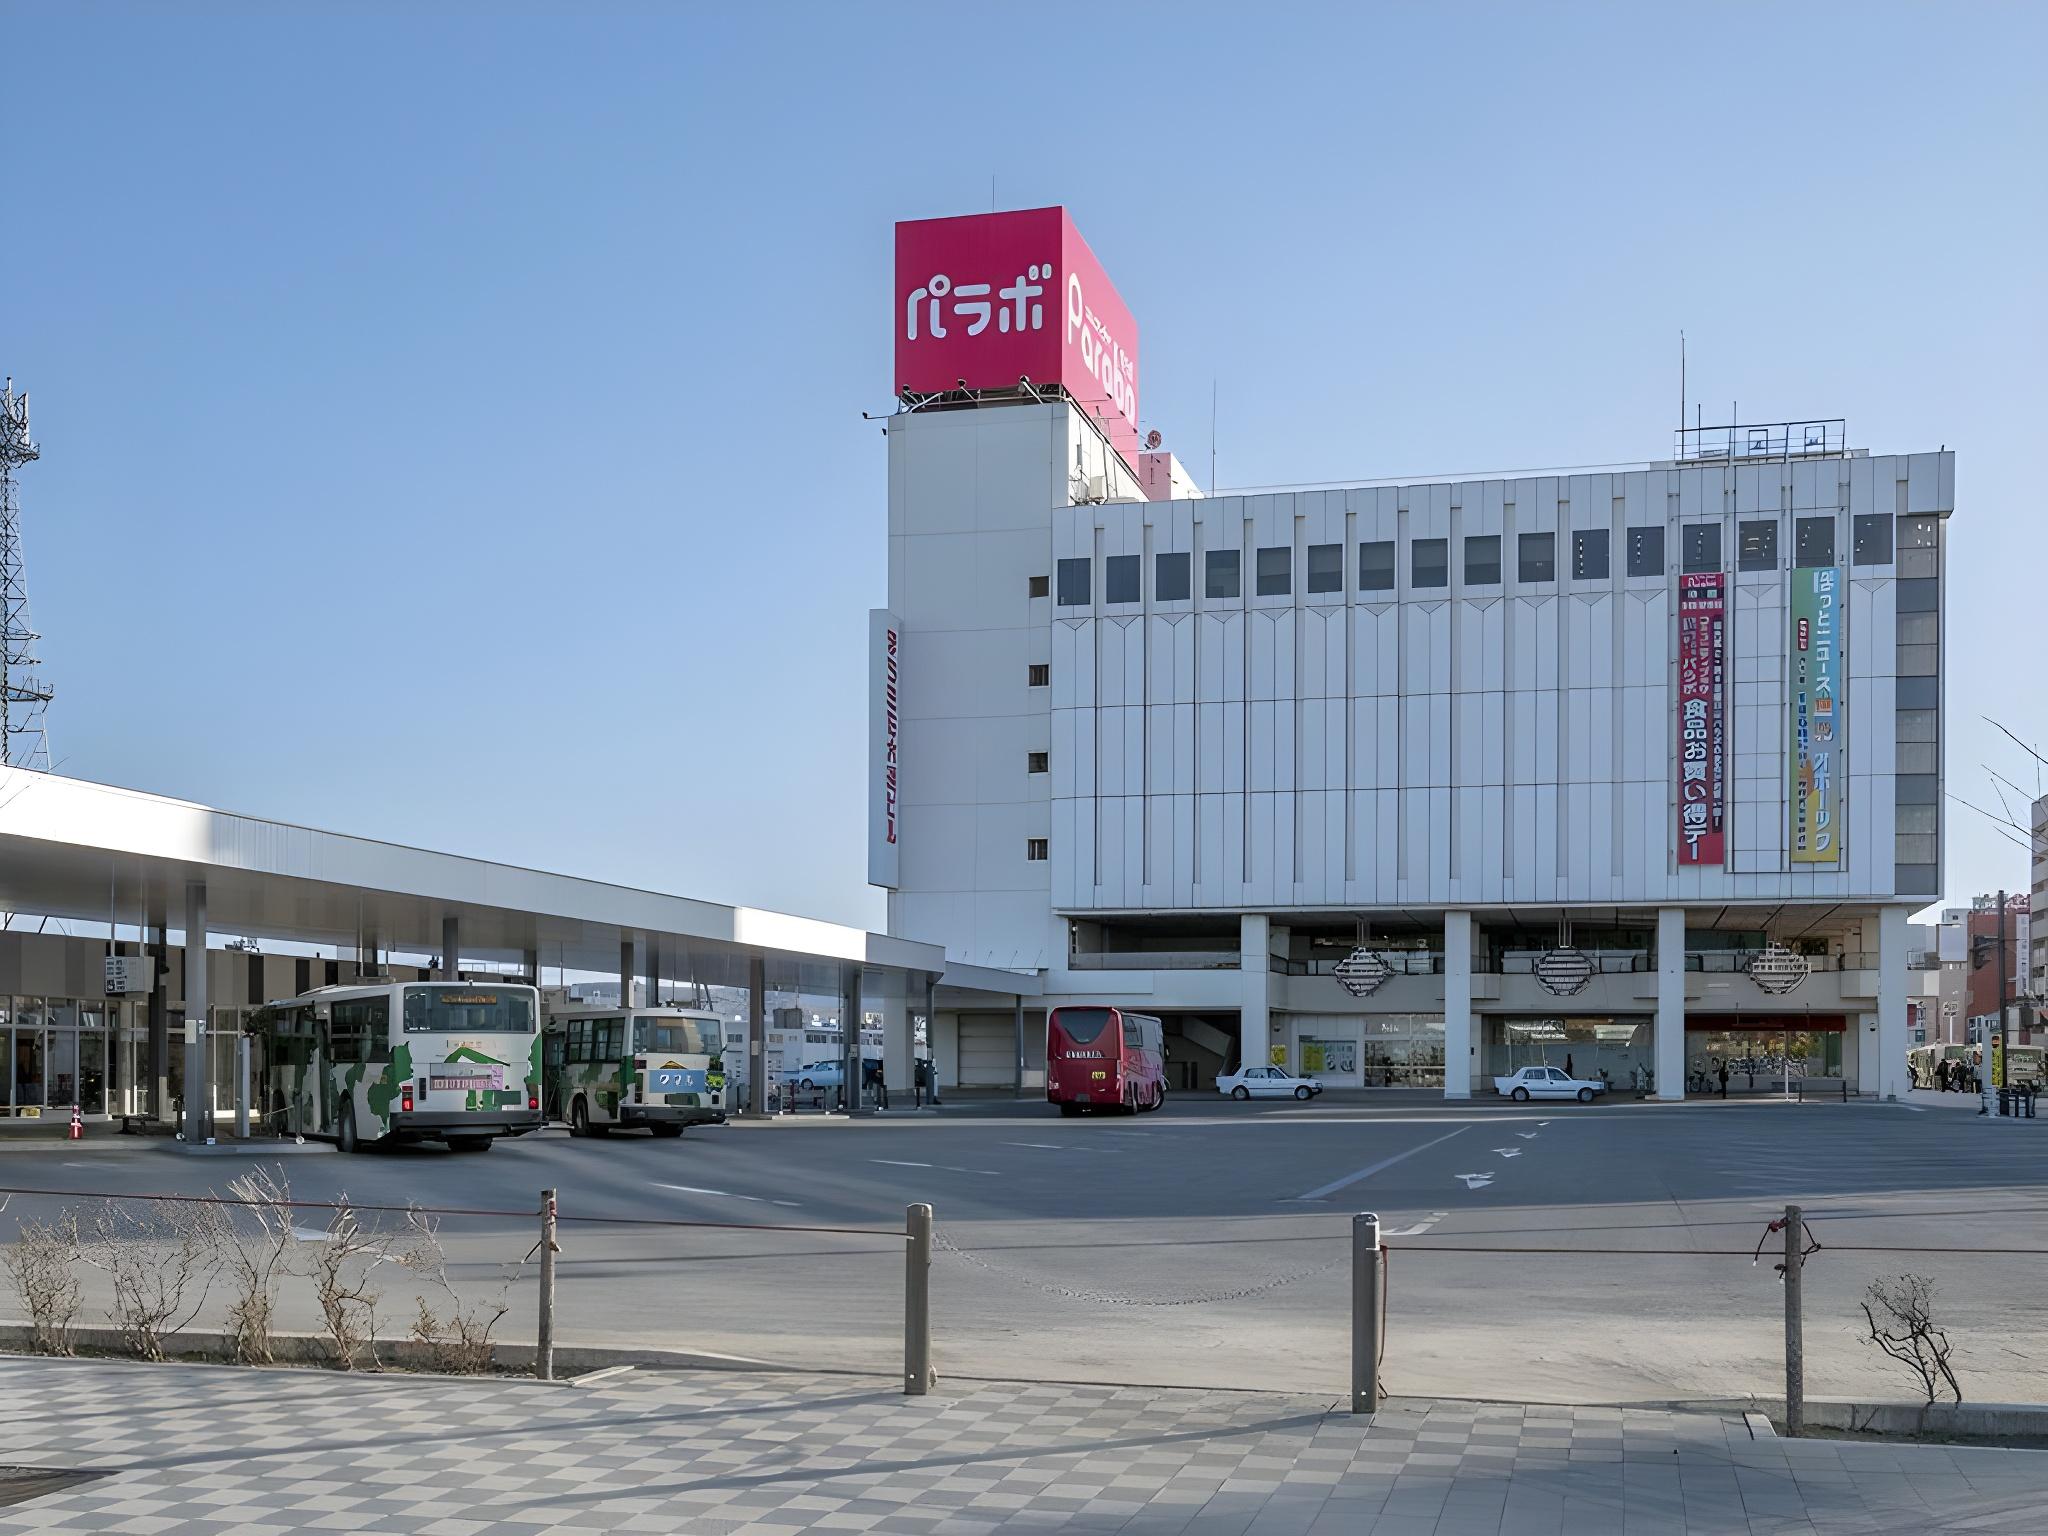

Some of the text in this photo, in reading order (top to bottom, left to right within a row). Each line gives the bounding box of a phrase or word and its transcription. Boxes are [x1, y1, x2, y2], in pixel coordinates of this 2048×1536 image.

[907, 263, 1052, 341] パラボ
[1068, 272, 1136, 427] Parabo
